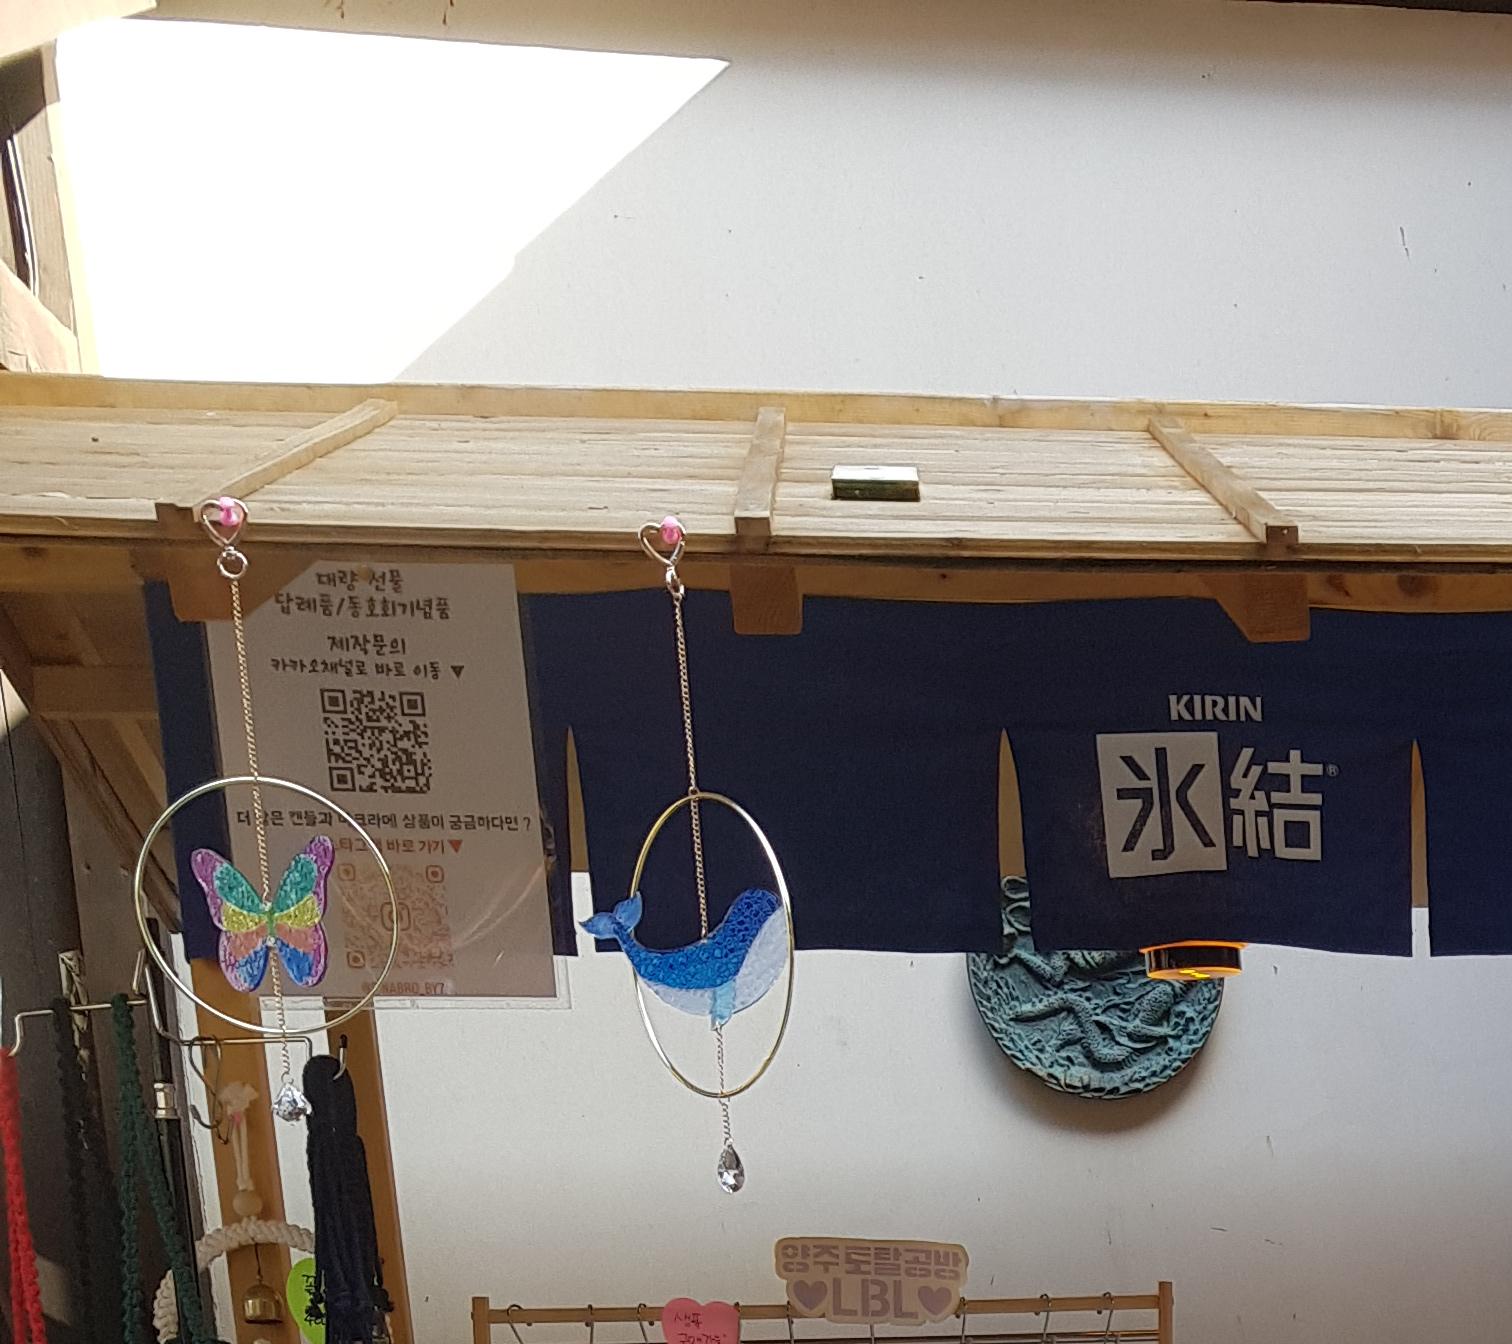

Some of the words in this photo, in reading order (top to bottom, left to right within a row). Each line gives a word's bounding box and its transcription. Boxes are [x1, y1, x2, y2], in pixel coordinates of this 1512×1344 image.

[316, 569, 359, 592] 대량
[369, 568, 404, 594] 선물
[327, 633, 407, 656] 제작문의
[270, 657, 368, 678] 카카오채널로
[375, 661, 407, 678] 바로
[412, 660, 442, 681] 이동
[1168, 694, 1263, 722] KIRIN
[1114, 746, 1324, 863] 氷結
[236, 810, 251, 826] 더
[402, 813, 445, 831] 상품이
[448, 814, 519, 832] 궁금하다면
[832, 1278, 918, 1319] LBL
